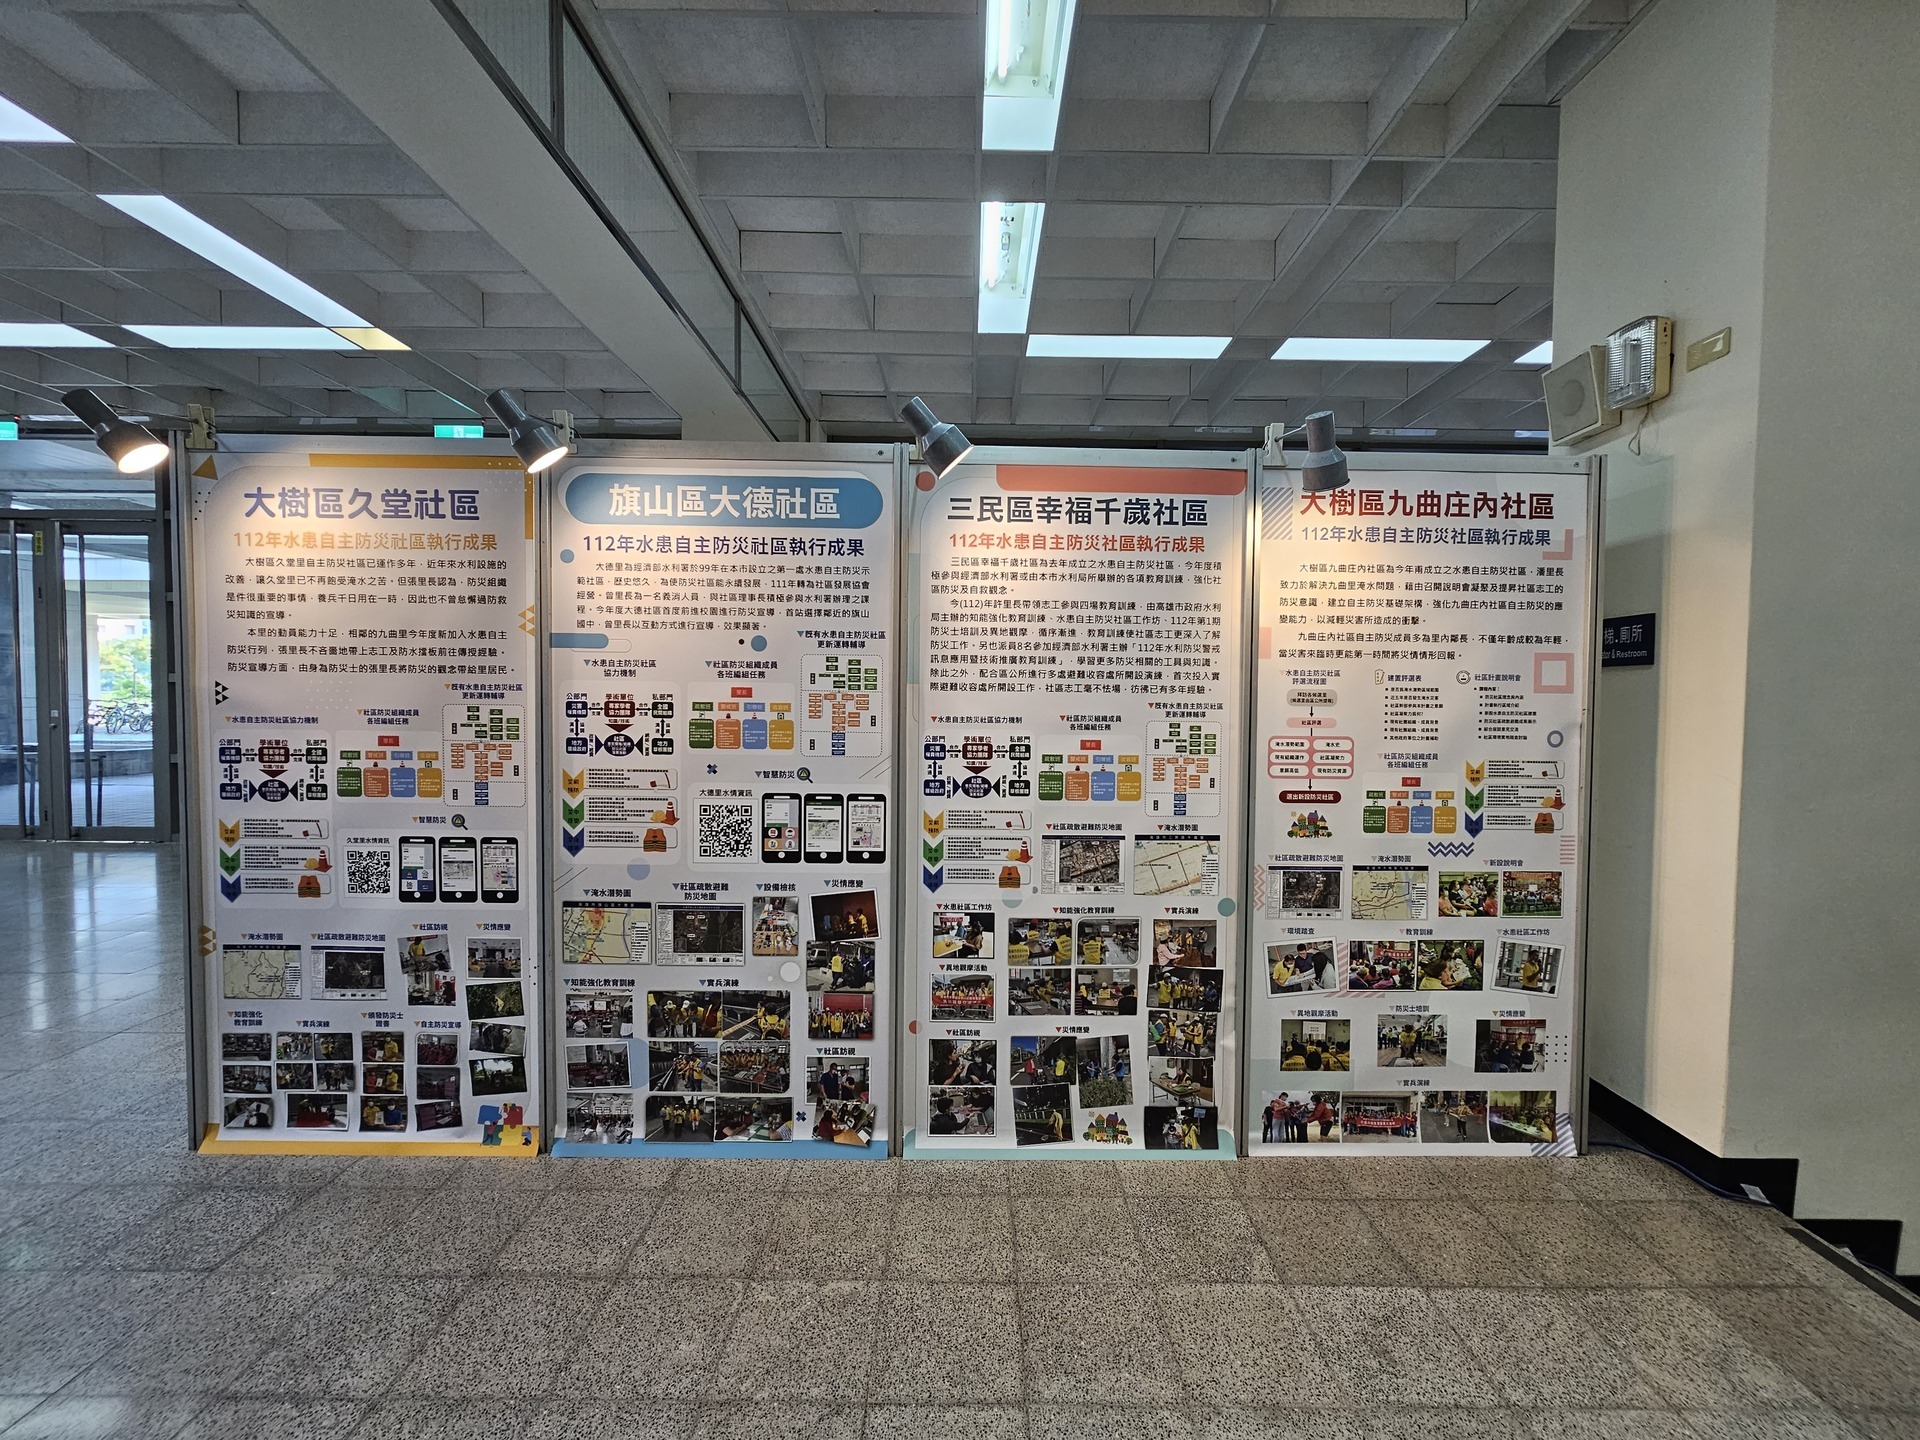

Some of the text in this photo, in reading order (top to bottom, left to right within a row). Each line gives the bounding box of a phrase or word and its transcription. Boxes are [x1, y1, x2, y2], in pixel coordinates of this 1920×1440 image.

[243, 486, 480, 521] 大樹區久堂社區
[609, 484, 840, 519] 旗山區大德社區
[948, 495, 1209, 527] 三民區幸福千歲社區
[1299, 488, 1555, 520] 大樹區九曲庄內社區
[234, 531, 498, 551] 112年水患自主防災社區執行成果
[582, 535, 865, 557] 112年水患自主防災社區執行成果
[949, 532, 1205, 554] 112年水患自主防災社區執行成果
[1301, 525, 1551, 547] 112年水患自主防災社區執行成果
[1616, 650, 1647, 658] Restroom
[763, 770, 795, 779] 智慧防災
